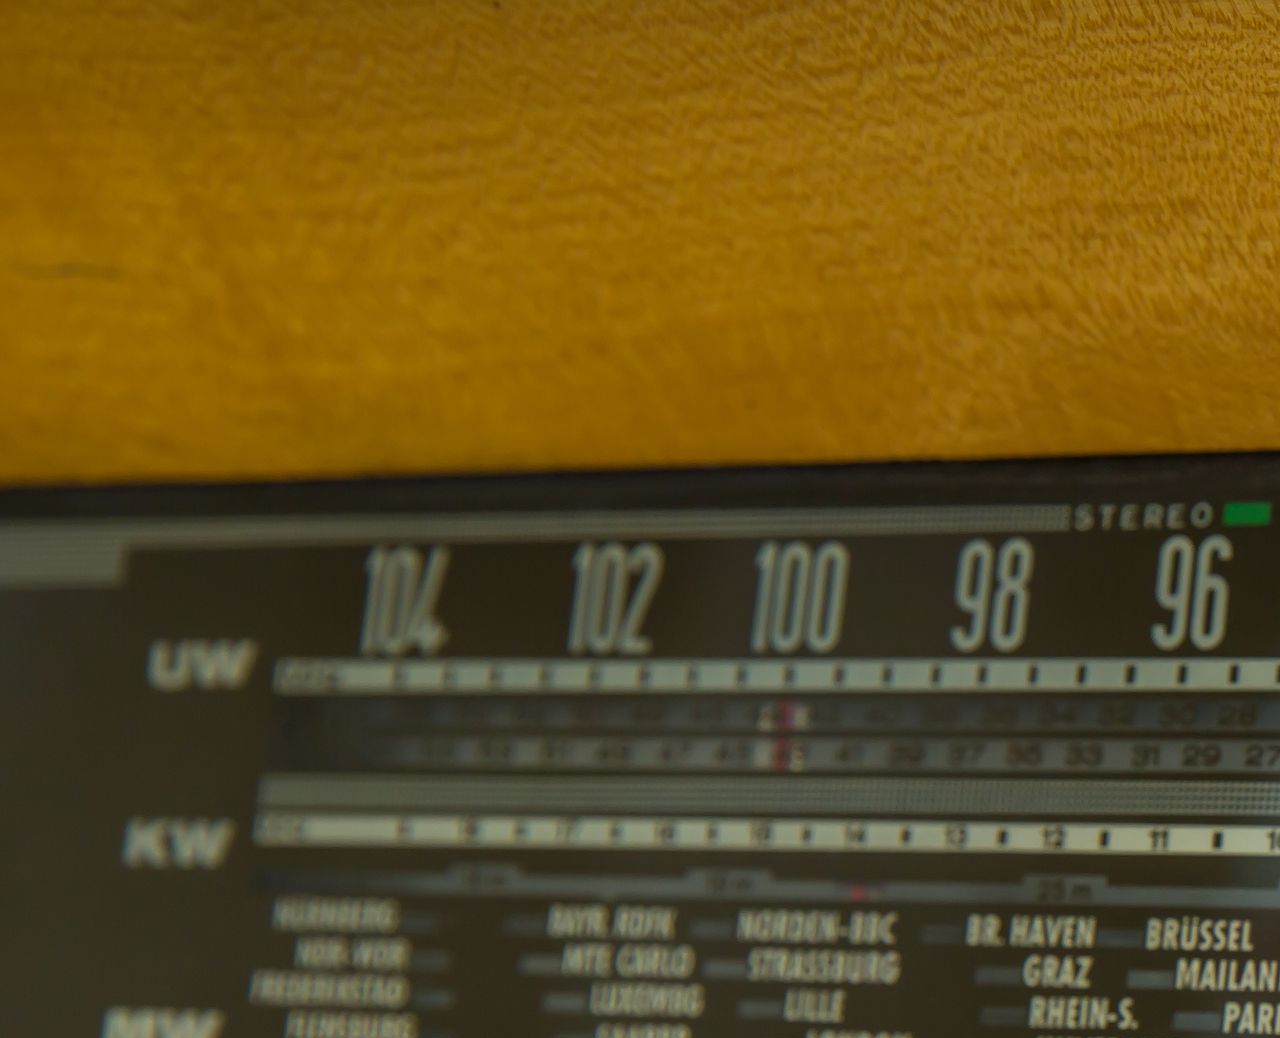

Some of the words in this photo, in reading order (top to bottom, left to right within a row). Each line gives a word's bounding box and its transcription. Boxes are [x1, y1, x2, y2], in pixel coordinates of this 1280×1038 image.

[1075, 503, 1213, 530] STEREO
[361, 544, 451, 655] 104
[569, 542, 663, 653] 102
[751, 541, 850, 653] 100
[950, 537, 1034, 653] 98
[1151, 535, 1233, 650] 96
[148, 639, 257, 690] UW
[1182, 745, 1222, 767] 29
[121, 817, 235, 868] KW
[965, 914, 1004, 946] BR.
[1010, 915, 1097, 949] HAVEN
[1145, 917, 1254, 952] BRÜSSEL
[1023, 955, 1093, 989] GRAZ
[1029, 996, 1139, 1031] RHEIN-S.
